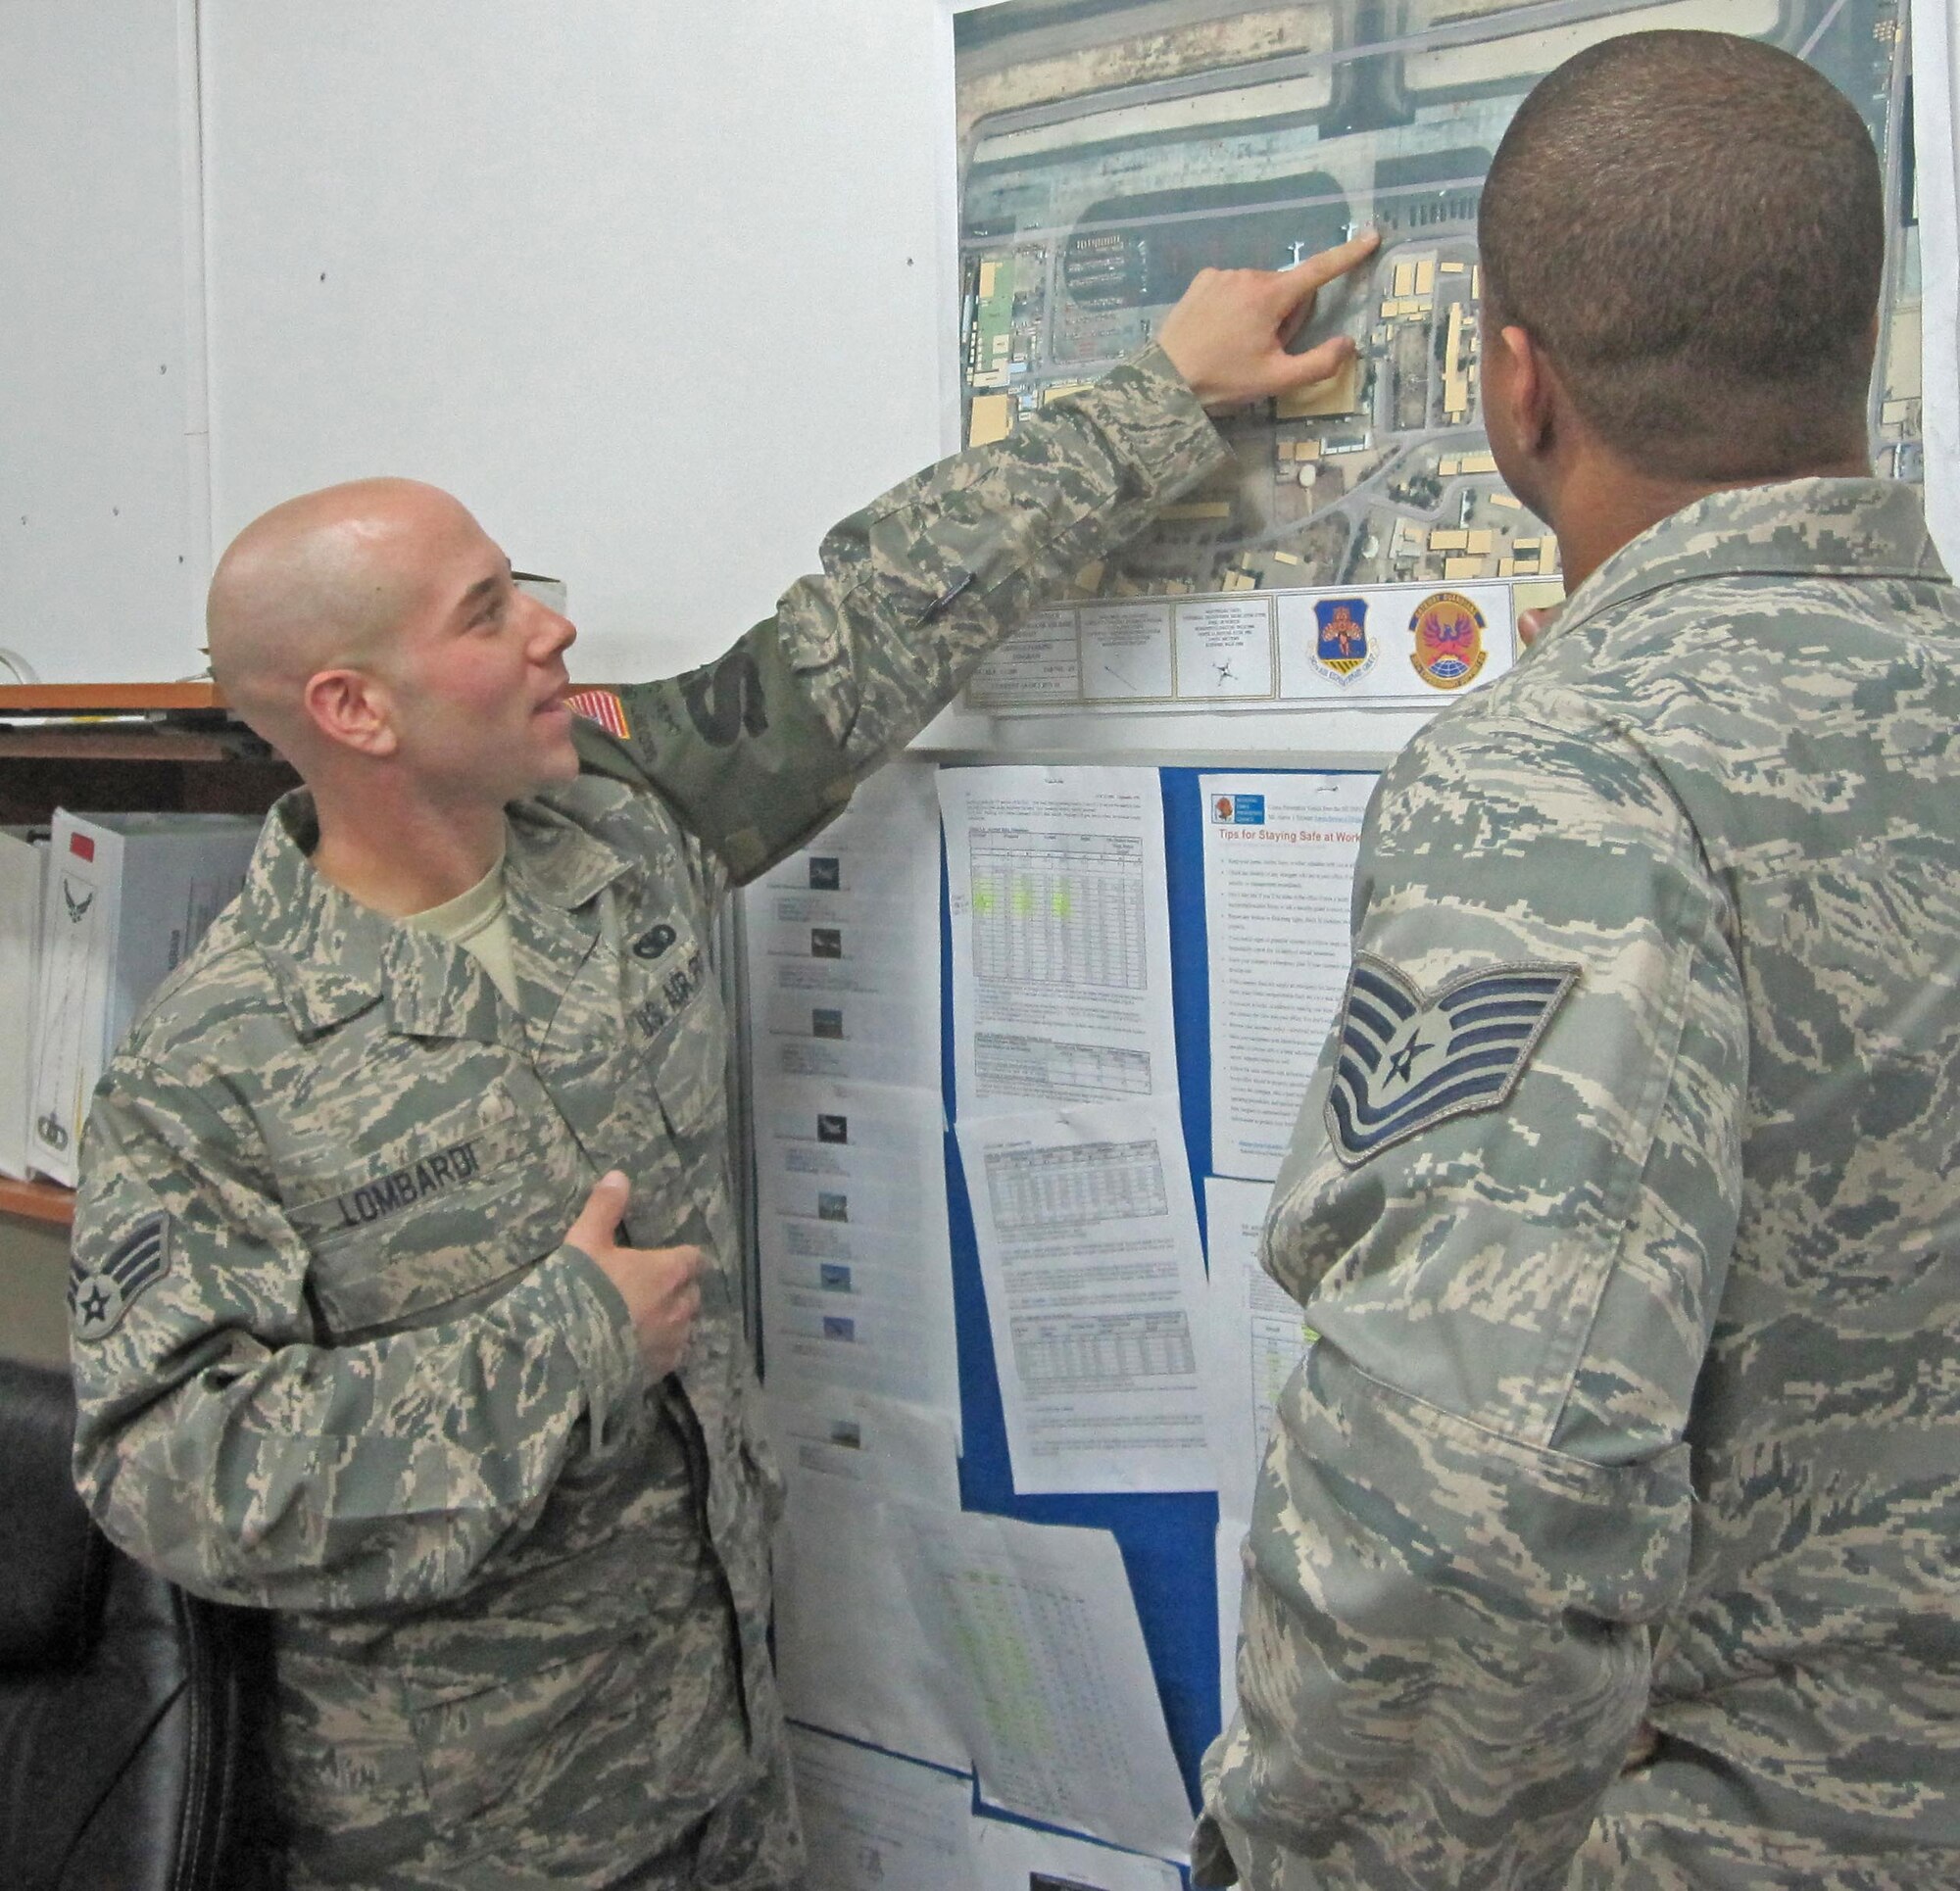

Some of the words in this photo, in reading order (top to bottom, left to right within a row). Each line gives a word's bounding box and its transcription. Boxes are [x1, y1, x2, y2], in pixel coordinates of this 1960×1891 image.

[1219, 829, 1239, 840] Tips
[1242, 829, 1256, 840] for
[1259, 830, 1297, 843] Staying
[1299, 831, 1321, 842] Safe
[1324, 833, 1334, 842] at
[1337, 833, 1361, 843] Work
[338, 1142, 479, 1226] LOMBARDI
